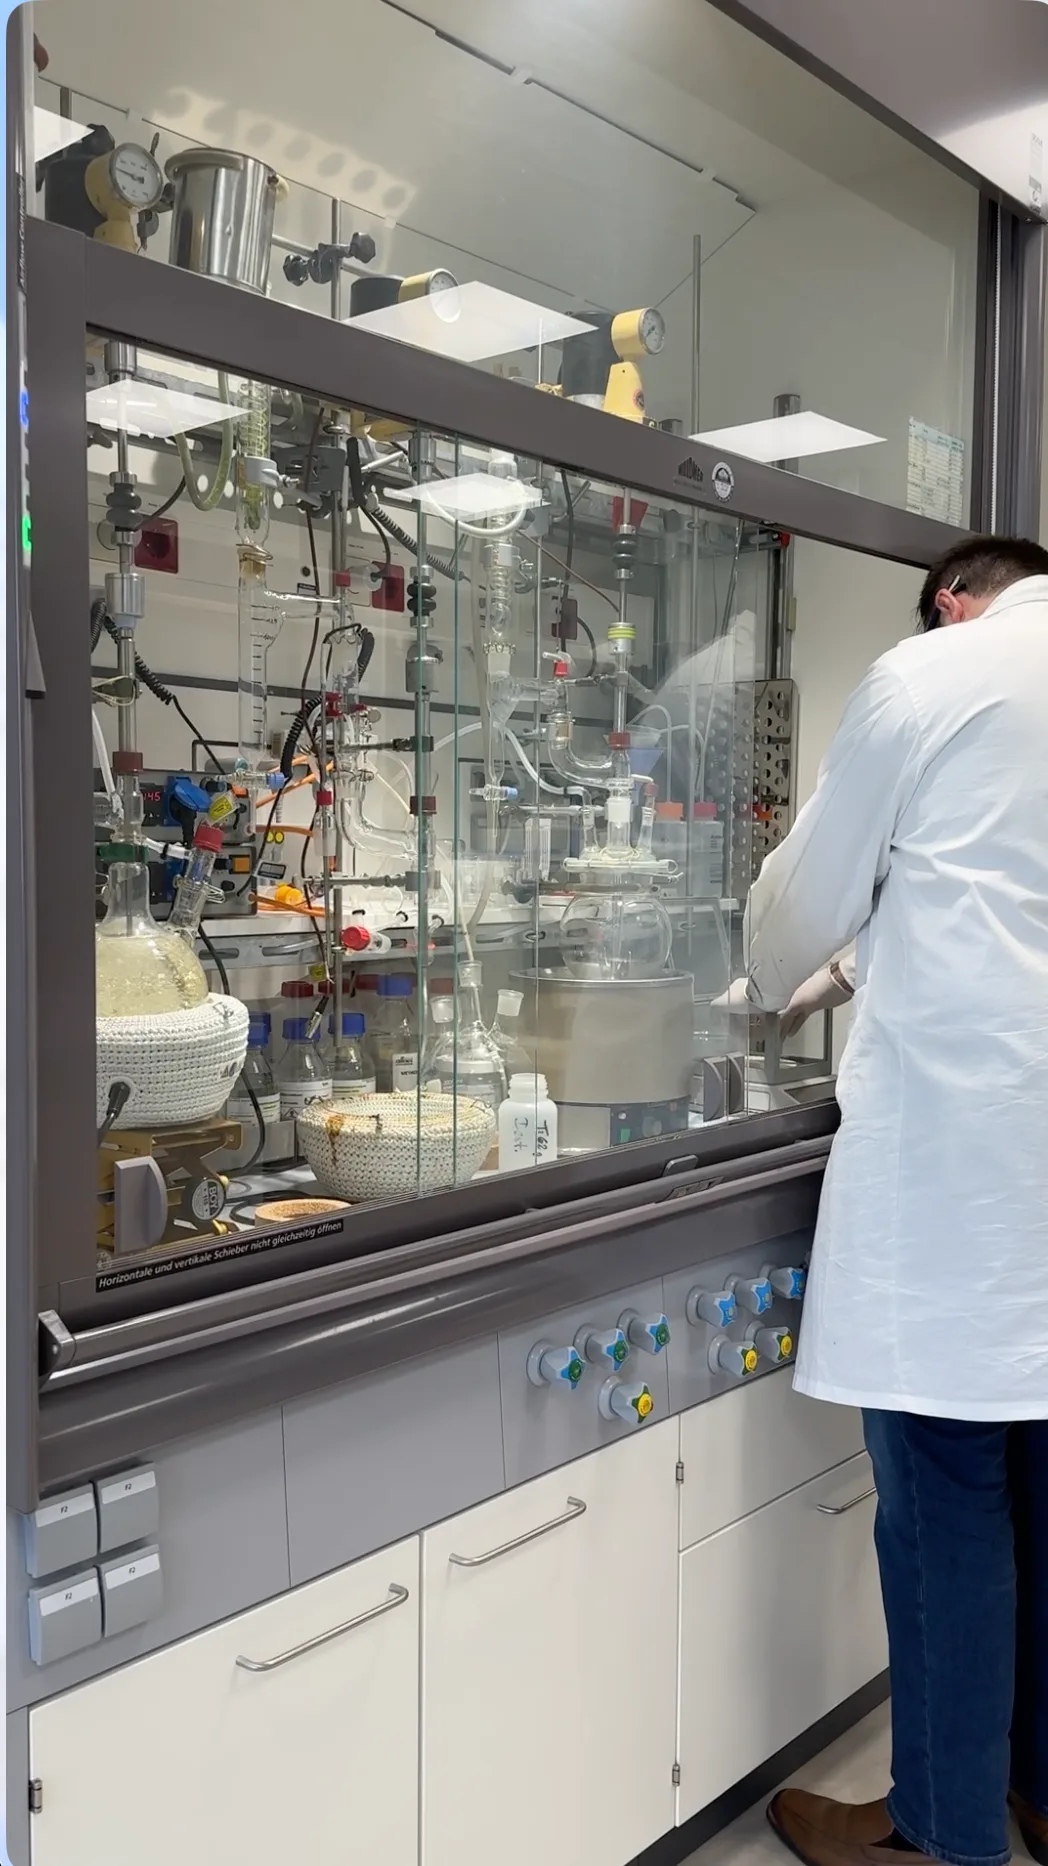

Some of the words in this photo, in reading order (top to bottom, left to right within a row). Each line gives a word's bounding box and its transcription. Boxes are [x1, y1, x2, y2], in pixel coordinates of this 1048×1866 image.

[208, 1186, 218, 1209] BOY
[98, 1266, 153, 1288] Horizontale
[155, 1261, 172, 1273] und
[174, 1252, 213, 1269] vertikale
[213, 1244, 250, 1260] Schieber
[250, 1238, 271, 1250] nicht
[272, 1229, 316, 1246] gleichzeitig
[317, 1222, 342, 1234] öffnen
